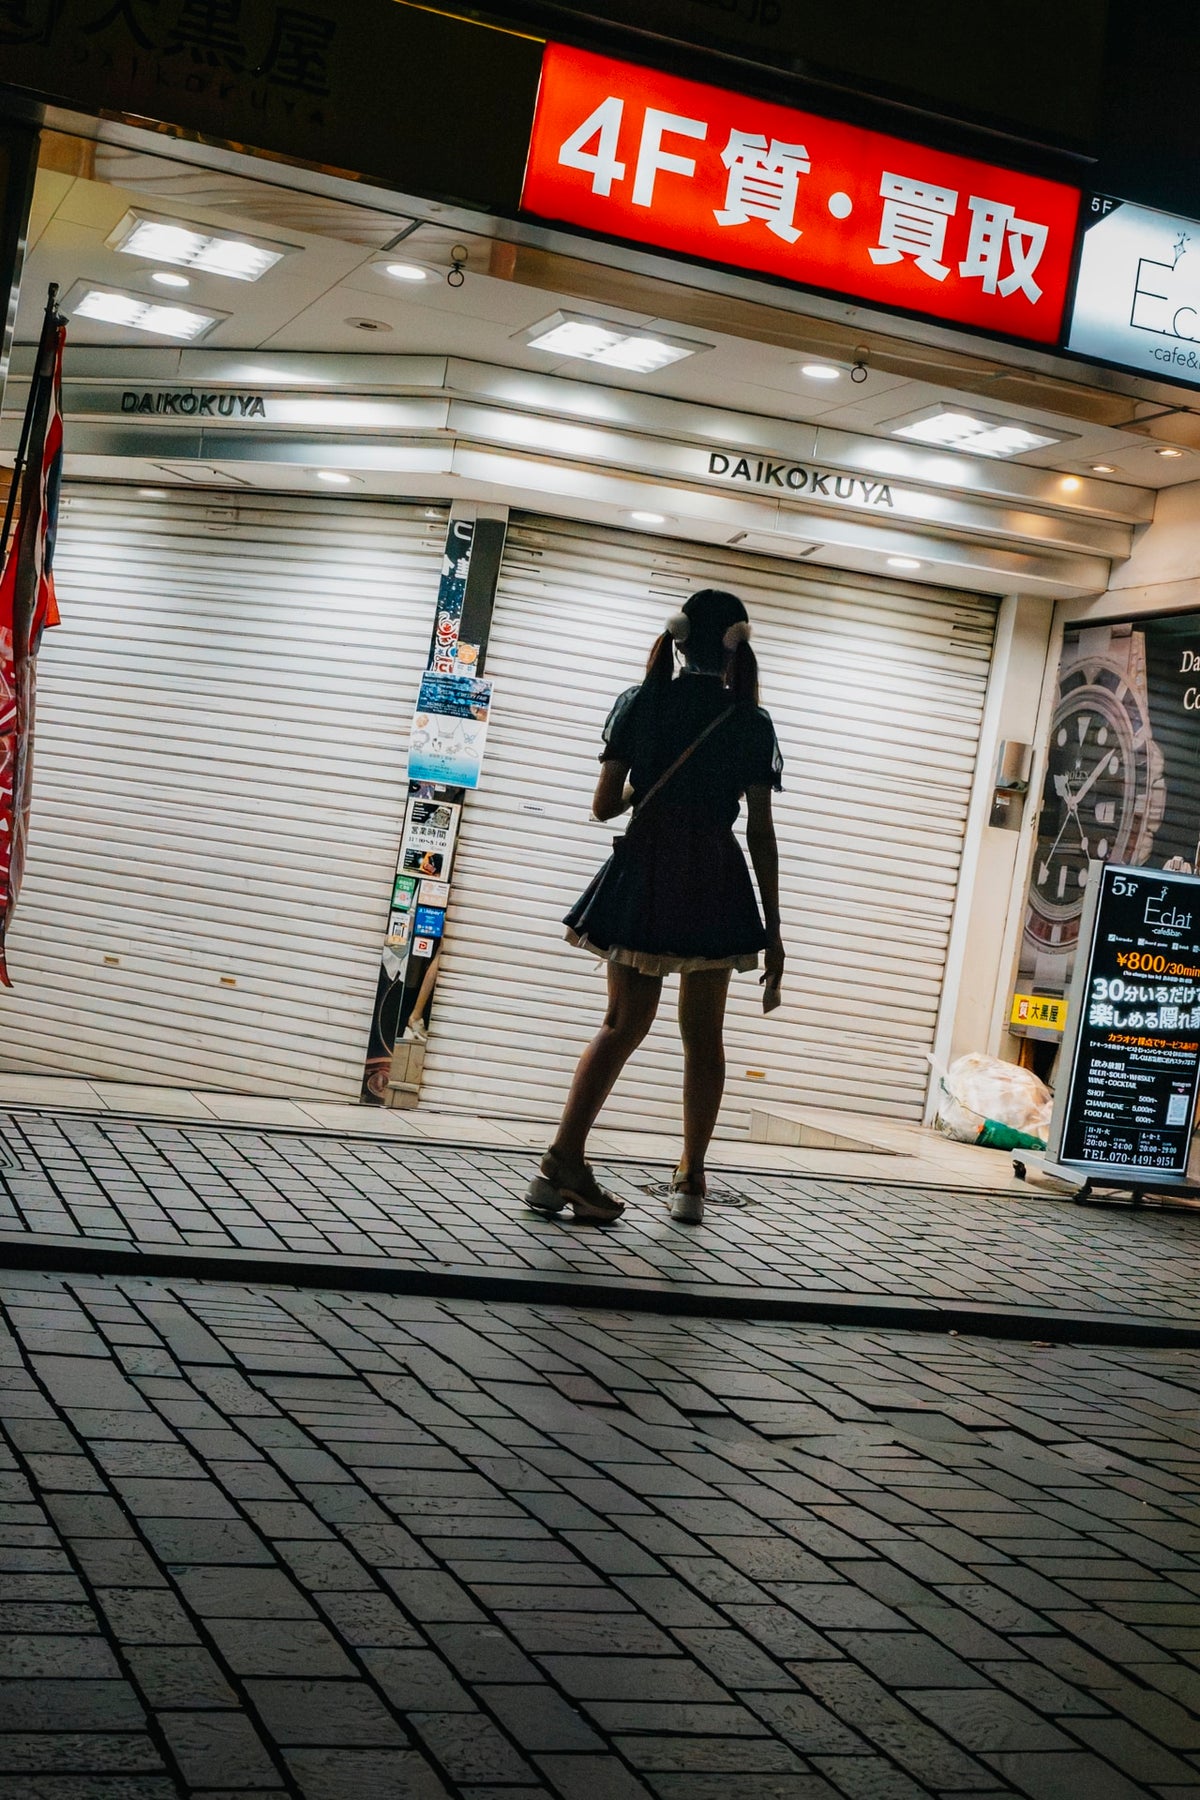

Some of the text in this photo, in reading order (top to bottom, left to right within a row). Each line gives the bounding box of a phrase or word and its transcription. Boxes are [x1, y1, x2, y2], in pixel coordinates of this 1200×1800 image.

[1091, 197, 1112, 215] 5F
[121, 391, 267, 418] DAIKOKUYA
[708, 452, 894, 508] DAIKOKUYA
[1112, 875, 1139, 897] 5F
[1031, 1002, 1060, 1023] 大黒屋
[1086, 1088, 1106, 1098] SHOT
[1083, 1109, 1103, 1118] FOOD
